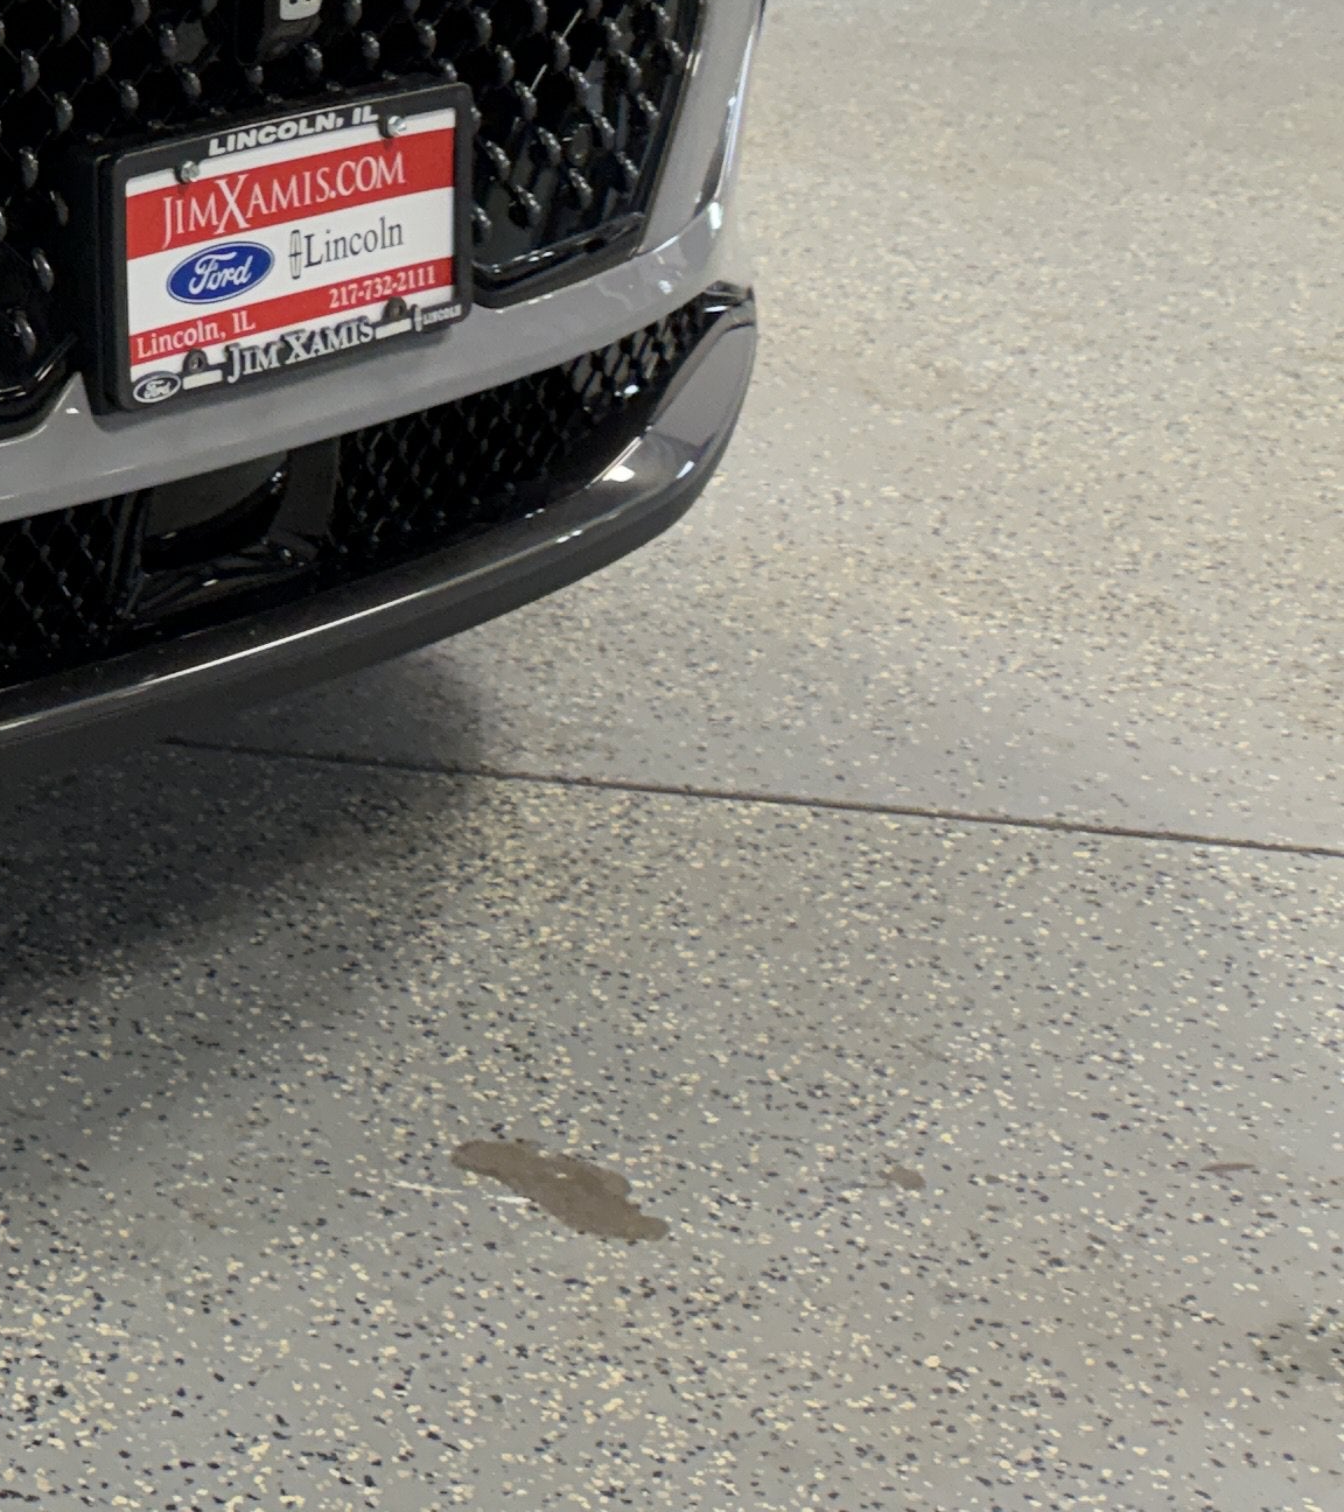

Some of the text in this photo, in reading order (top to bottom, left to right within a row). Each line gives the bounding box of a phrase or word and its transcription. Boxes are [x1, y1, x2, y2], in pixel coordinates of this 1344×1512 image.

[352, 105, 379, 125] IL
[162, 150, 407, 249] JIMXAMIS.COM
[304, 216, 404, 268] Lincoln
[188, 251, 254, 295] Ford
[328, 264, 436, 309] 217-732-2111
[136, 310, 257, 359] Lincoln, IL
[226, 321, 374, 384] JIM XAMIS
